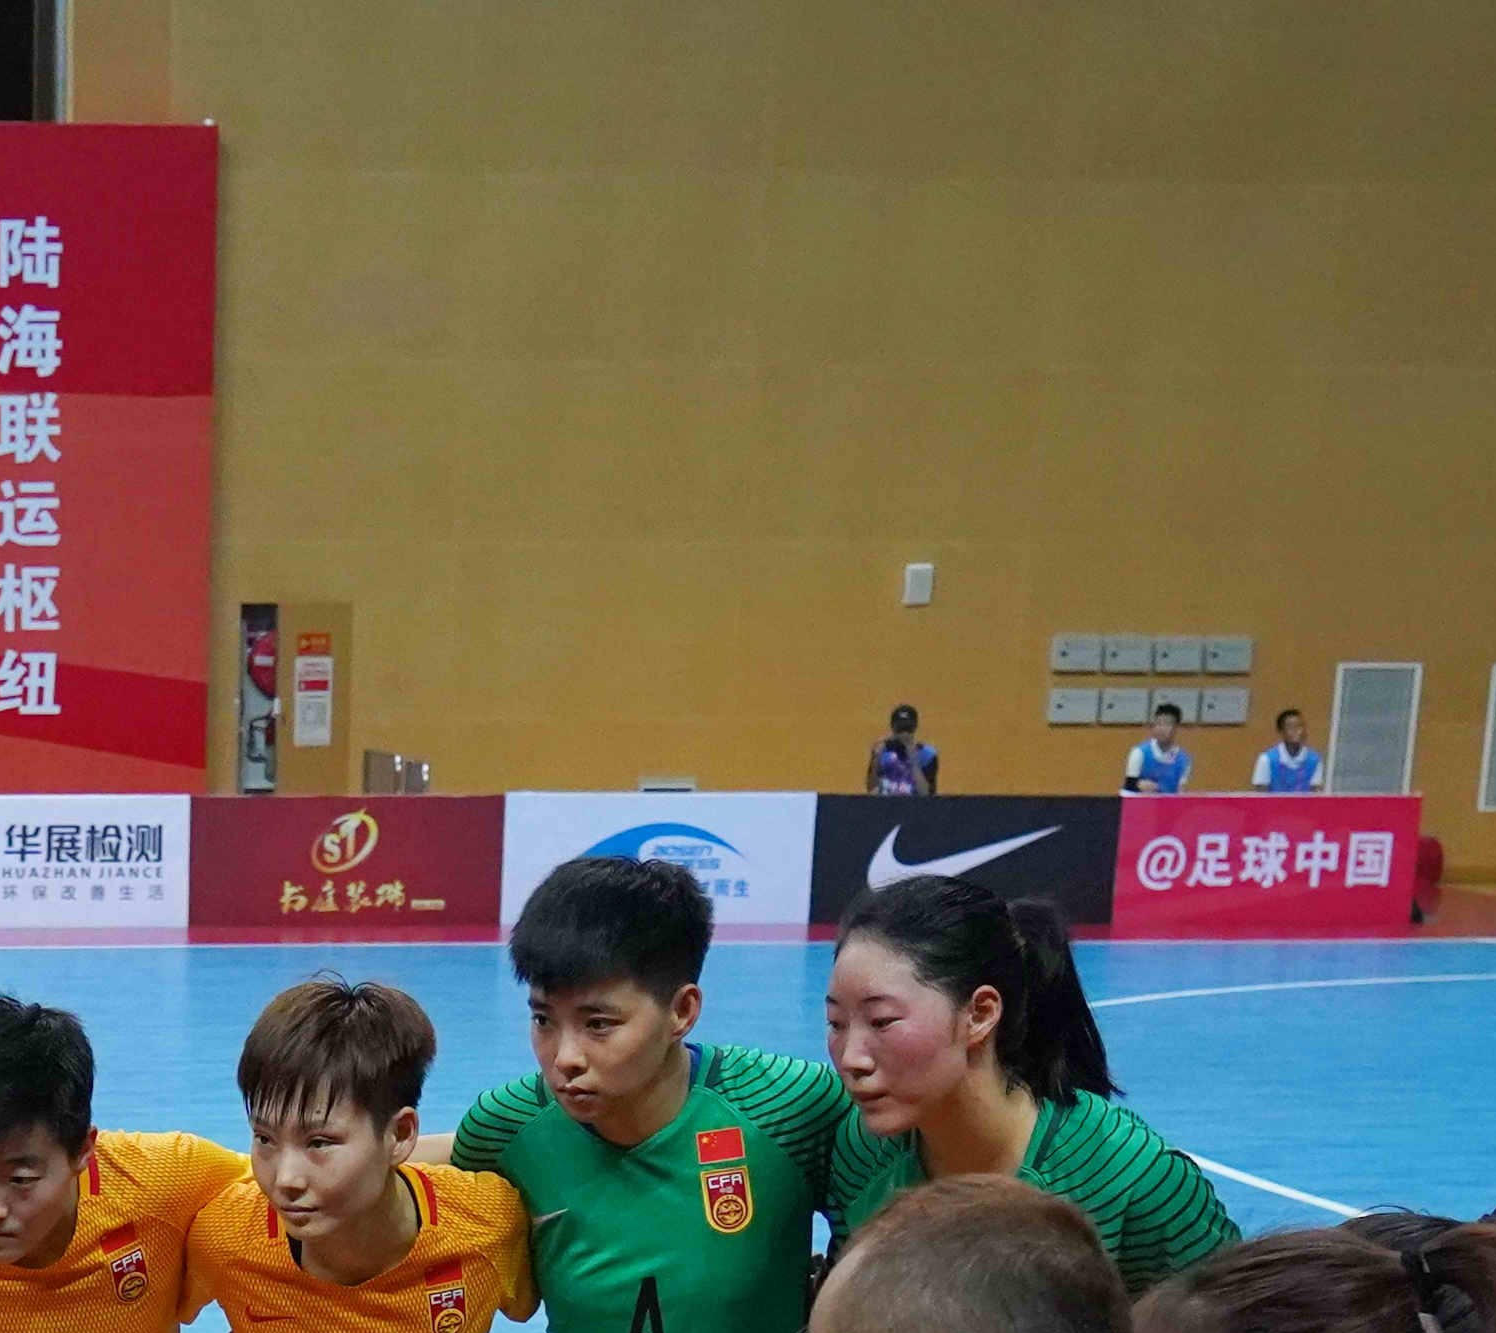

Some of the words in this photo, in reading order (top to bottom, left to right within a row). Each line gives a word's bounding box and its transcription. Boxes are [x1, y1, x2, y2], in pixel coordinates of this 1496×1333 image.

[3, 824, 164, 864] 华展检测
[1136, 830, 1394, 891] @足球中国
[2, 866, 92, 880] HUAZHAN
[98, 866, 164, 879] JIANCE
[2, 884, 165, 901] 环保改善生活
[707, 1173, 743, 1190] CFA
[111, 1250, 144, 1274] CFA
[429, 1289, 464, 1304] CFA
